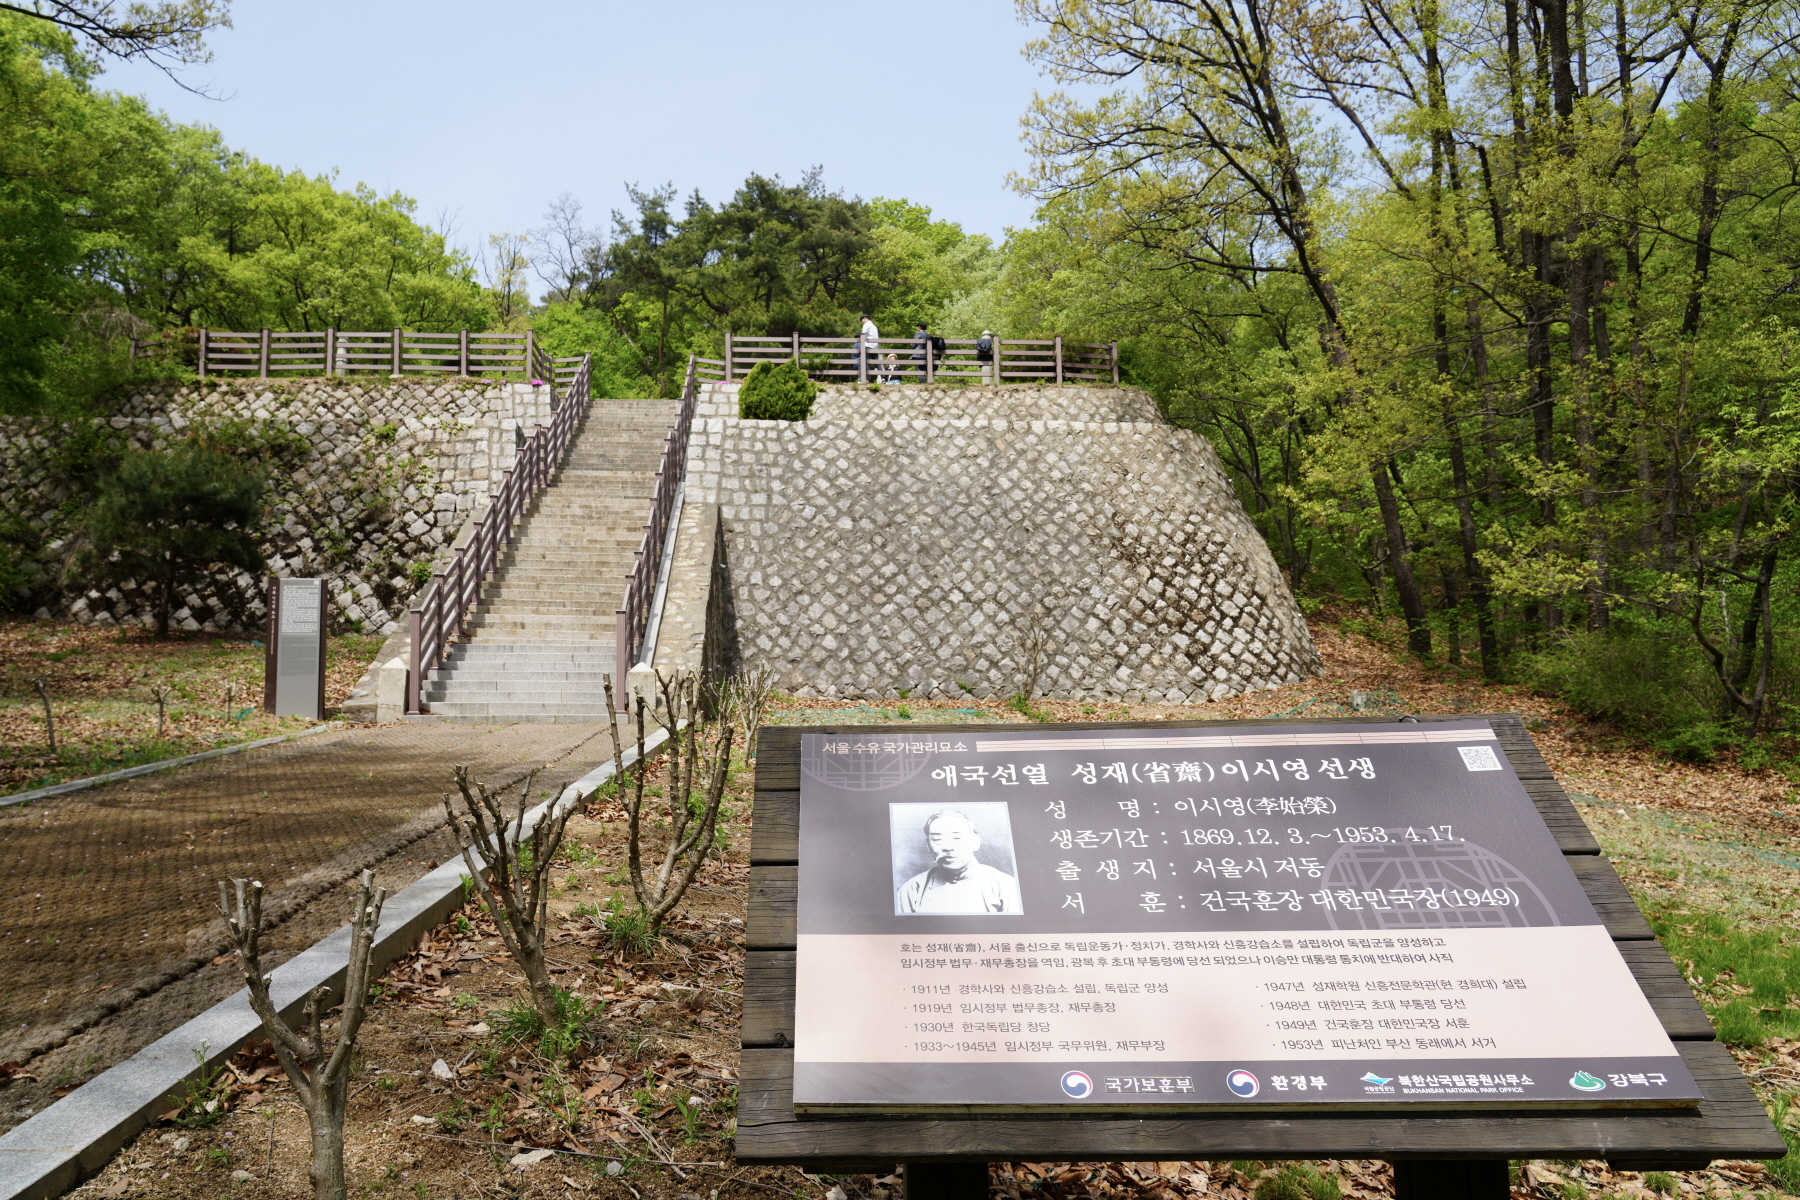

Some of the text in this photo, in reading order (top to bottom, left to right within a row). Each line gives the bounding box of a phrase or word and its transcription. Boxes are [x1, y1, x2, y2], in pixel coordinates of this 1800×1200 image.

[822, 741, 968, 754] 서울 수유 국가관리묘소
[931, 763, 1049, 787] 애국선열
[1317, 757, 1377, 780] 선생
[1174, 796, 1337, 817] 이시영(李始榮)
[1050, 828, 1149, 849] 생존기간
[1193, 857, 1268, 879] 서울시
[1273, 857, 1325, 878] 저동
[1199, 889, 1304, 912] 건국훈장
[1309, 887, 1520, 912] 대한민국장(1949)
[900, 943, 923, 953] 호는
[989, 942, 1012, 953] 서울
[1014, 942, 1062, 952] 출신으로
[1173, 940, 1220, 951] 경학사와
[1223, 939, 1294, 950] 신흥강습소를
[1297, 938, 1345, 949] 설립하여
[1347, 938, 1395, 949] 독립군을
[1397, 937, 1447, 948] 양성하고
[900, 958, 948, 969] 임시정부
[1041, 957, 1069, 968] 역임,
[1071, 956, 1095, 968] 광복
[1111, 956, 1135, 967] 초대
[1136, 955, 1185, 967] 부통령에
[1263, 954, 1300, 965] 이승만
[1301, 954, 1337, 965] 대통령
[1339, 953, 1376, 965] 통치에
[1377, 953, 1427, 964] 반대하여
[1428, 952, 1454, 964] 사직
[911, 982, 1169, 995] 1911년 경학사와 신흥강습소 설립, 독립군 양성
[1263, 978, 1527, 992] 1947년 성재학원 신흥전문학관(현 경희대) 설립
[912, 1002, 1116, 1014] 1919년 임시정부 법무총장, 재무총장
[1269, 999, 1467, 1011] 1948년 대한민국 초대 부통령 당선
[913, 1021, 1051, 1033] 1930년 한국독립당 창당
[1275, 1017, 1471, 1031] 1949년 건국훈장 대한민국장 서훈
[1004, 1040, 1054, 1052] 임시정부
[1057, 1040, 1112, 1052] 국무위원,
[1115, 1039, 1166, 1052] 재무부장
[1281, 1038, 1497, 1051] 1953년 피난처인 부산 동래에서 서거
[1105, 1077, 1194, 1093] 국가보훈부
[1271, 1075, 1328, 1091] 환경부
[1398, 1074, 1535, 1087] 북한산국립공원사무소
[1607, 1073, 1668, 1088] 강북구
